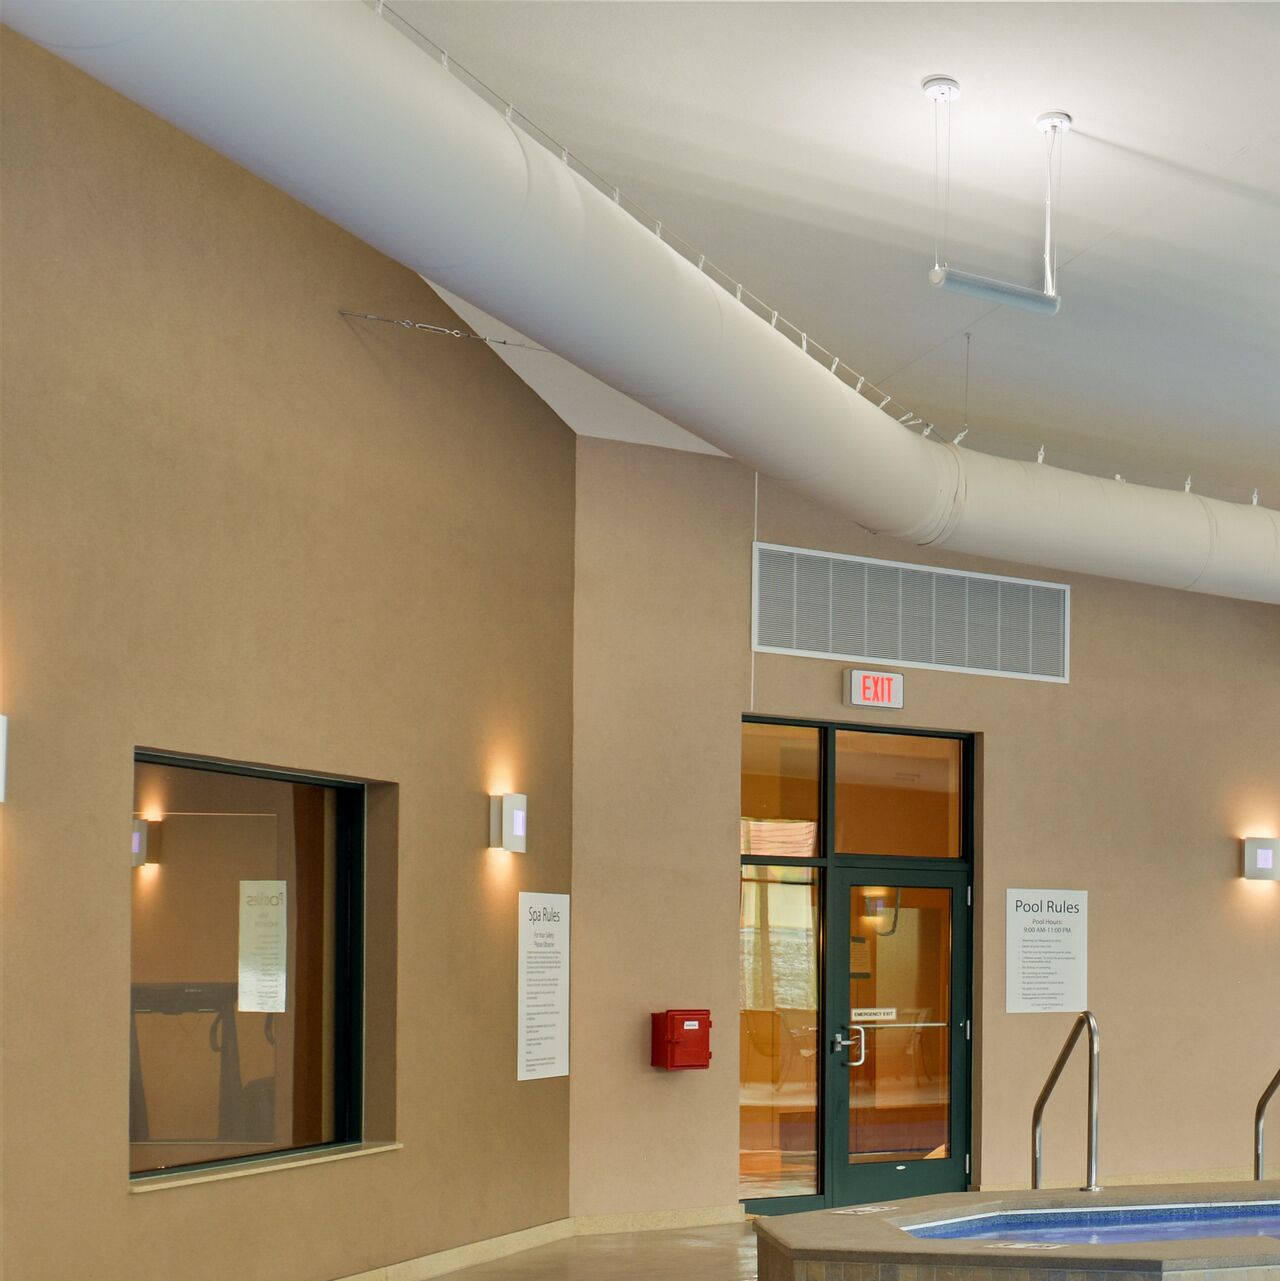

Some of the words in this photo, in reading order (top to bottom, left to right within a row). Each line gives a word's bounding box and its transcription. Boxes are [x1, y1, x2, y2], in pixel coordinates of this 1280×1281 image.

[862, 674, 894, 704] EXIT
[528, 906, 542, 925] Spa
[542, 906, 561, 922] Rules
[1015, 899, 1043, 913] Pool
[1047, 900, 1080, 914] Rules
